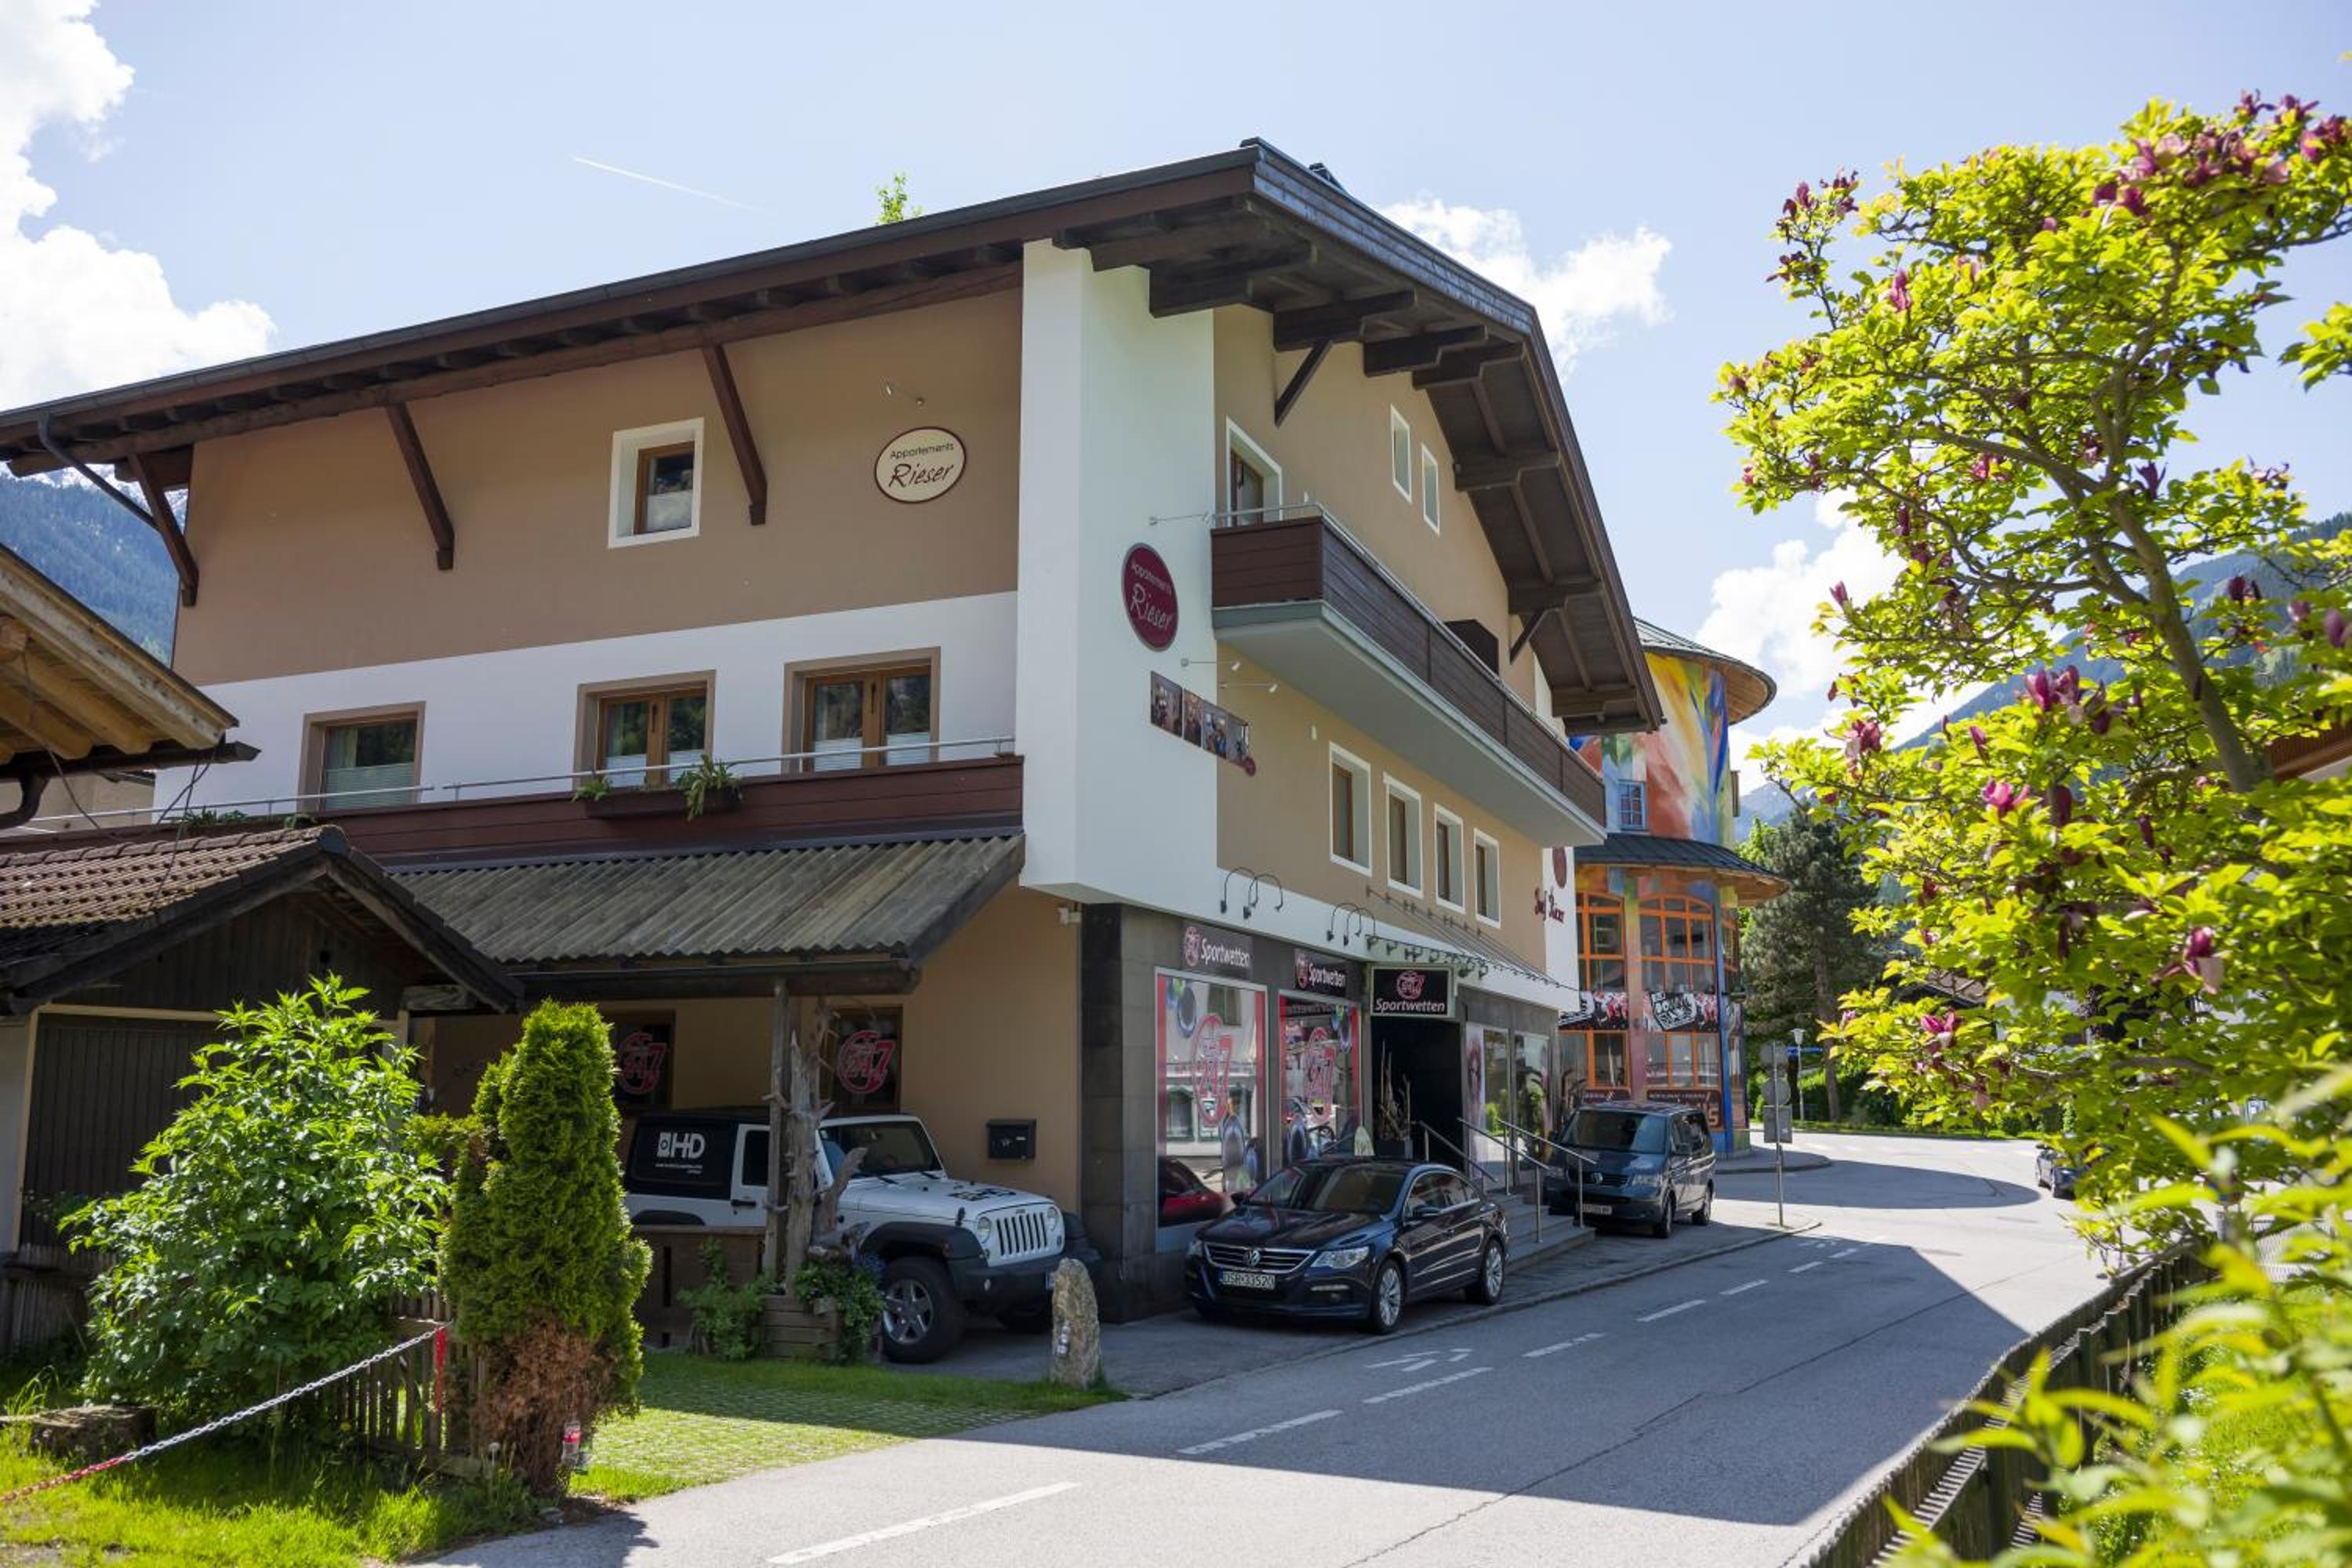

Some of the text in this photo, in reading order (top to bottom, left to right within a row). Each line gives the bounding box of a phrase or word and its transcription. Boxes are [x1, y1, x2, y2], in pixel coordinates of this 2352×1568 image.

[888, 463, 954, 488] Rieser
[1130, 583, 1174, 631] Rieser
[1200, 939, 1250, 967] Sportwetten
[1308, 963, 1346, 988] Sportwetten
[1375, 997, 1446, 1014] Sportwetten
